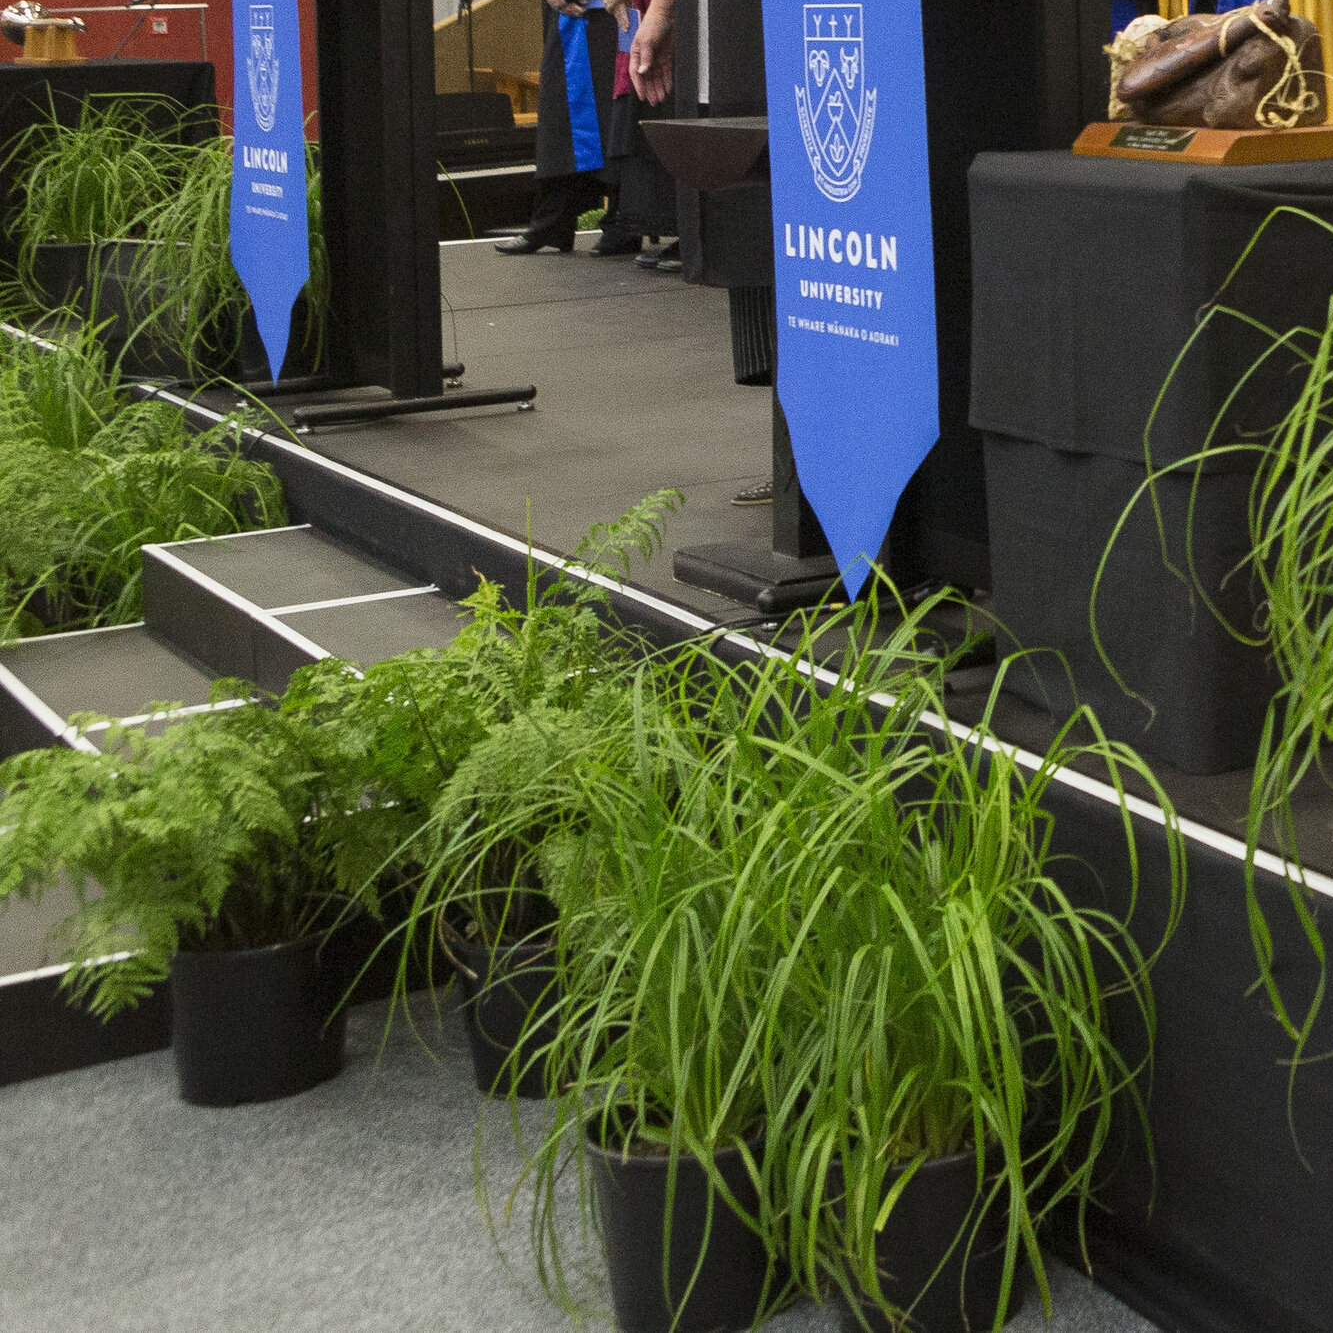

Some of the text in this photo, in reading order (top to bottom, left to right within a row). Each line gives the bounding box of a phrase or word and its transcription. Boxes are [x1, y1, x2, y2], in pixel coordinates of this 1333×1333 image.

[242, 144, 288, 174] LINCOLN
[785, 223, 898, 272] LINCOLN
[800, 279, 884, 311] UNIVERSITY
[787, 315, 797, 328] TE
[798, 317, 826, 334] WHARE
